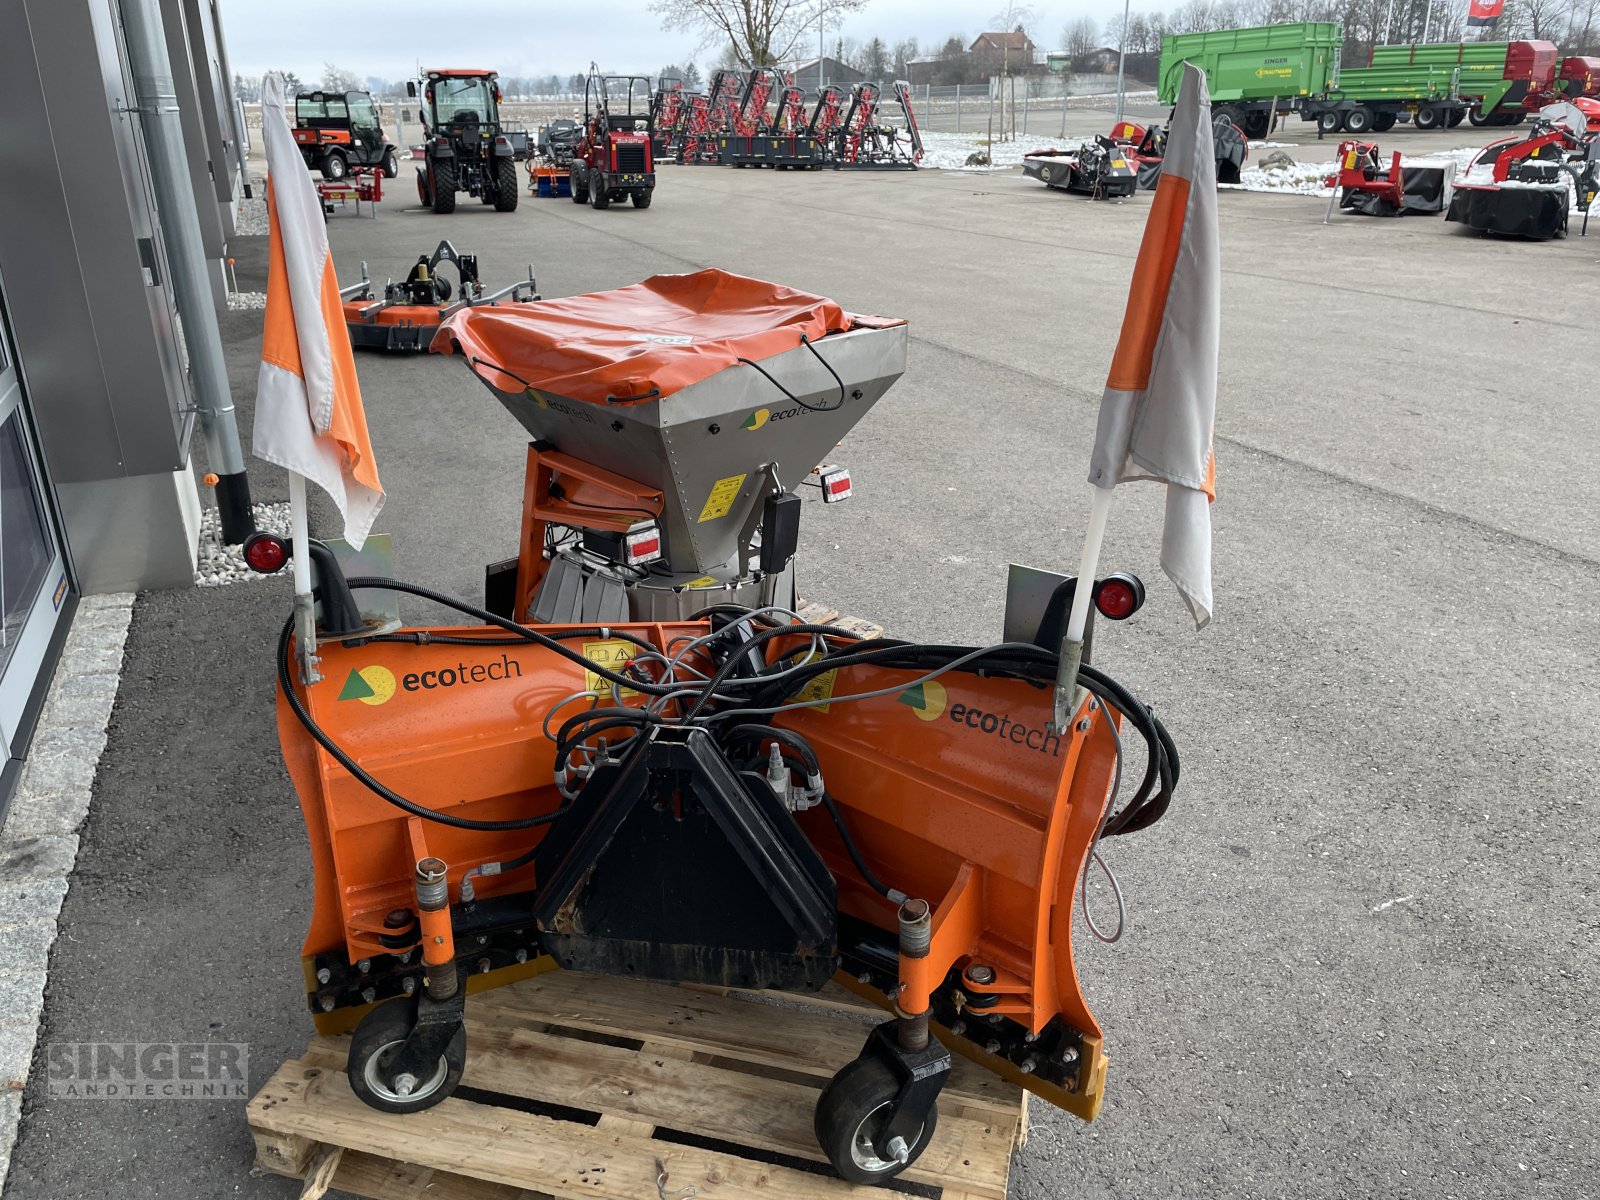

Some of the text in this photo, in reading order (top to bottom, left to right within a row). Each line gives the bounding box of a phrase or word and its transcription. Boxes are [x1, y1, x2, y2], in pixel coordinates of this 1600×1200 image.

[1263, 57, 1288, 65] SINGER
[546, 399, 597, 424] ecotech
[402, 654, 522, 692] ecotech
[950, 703, 1059, 757] ecotech
